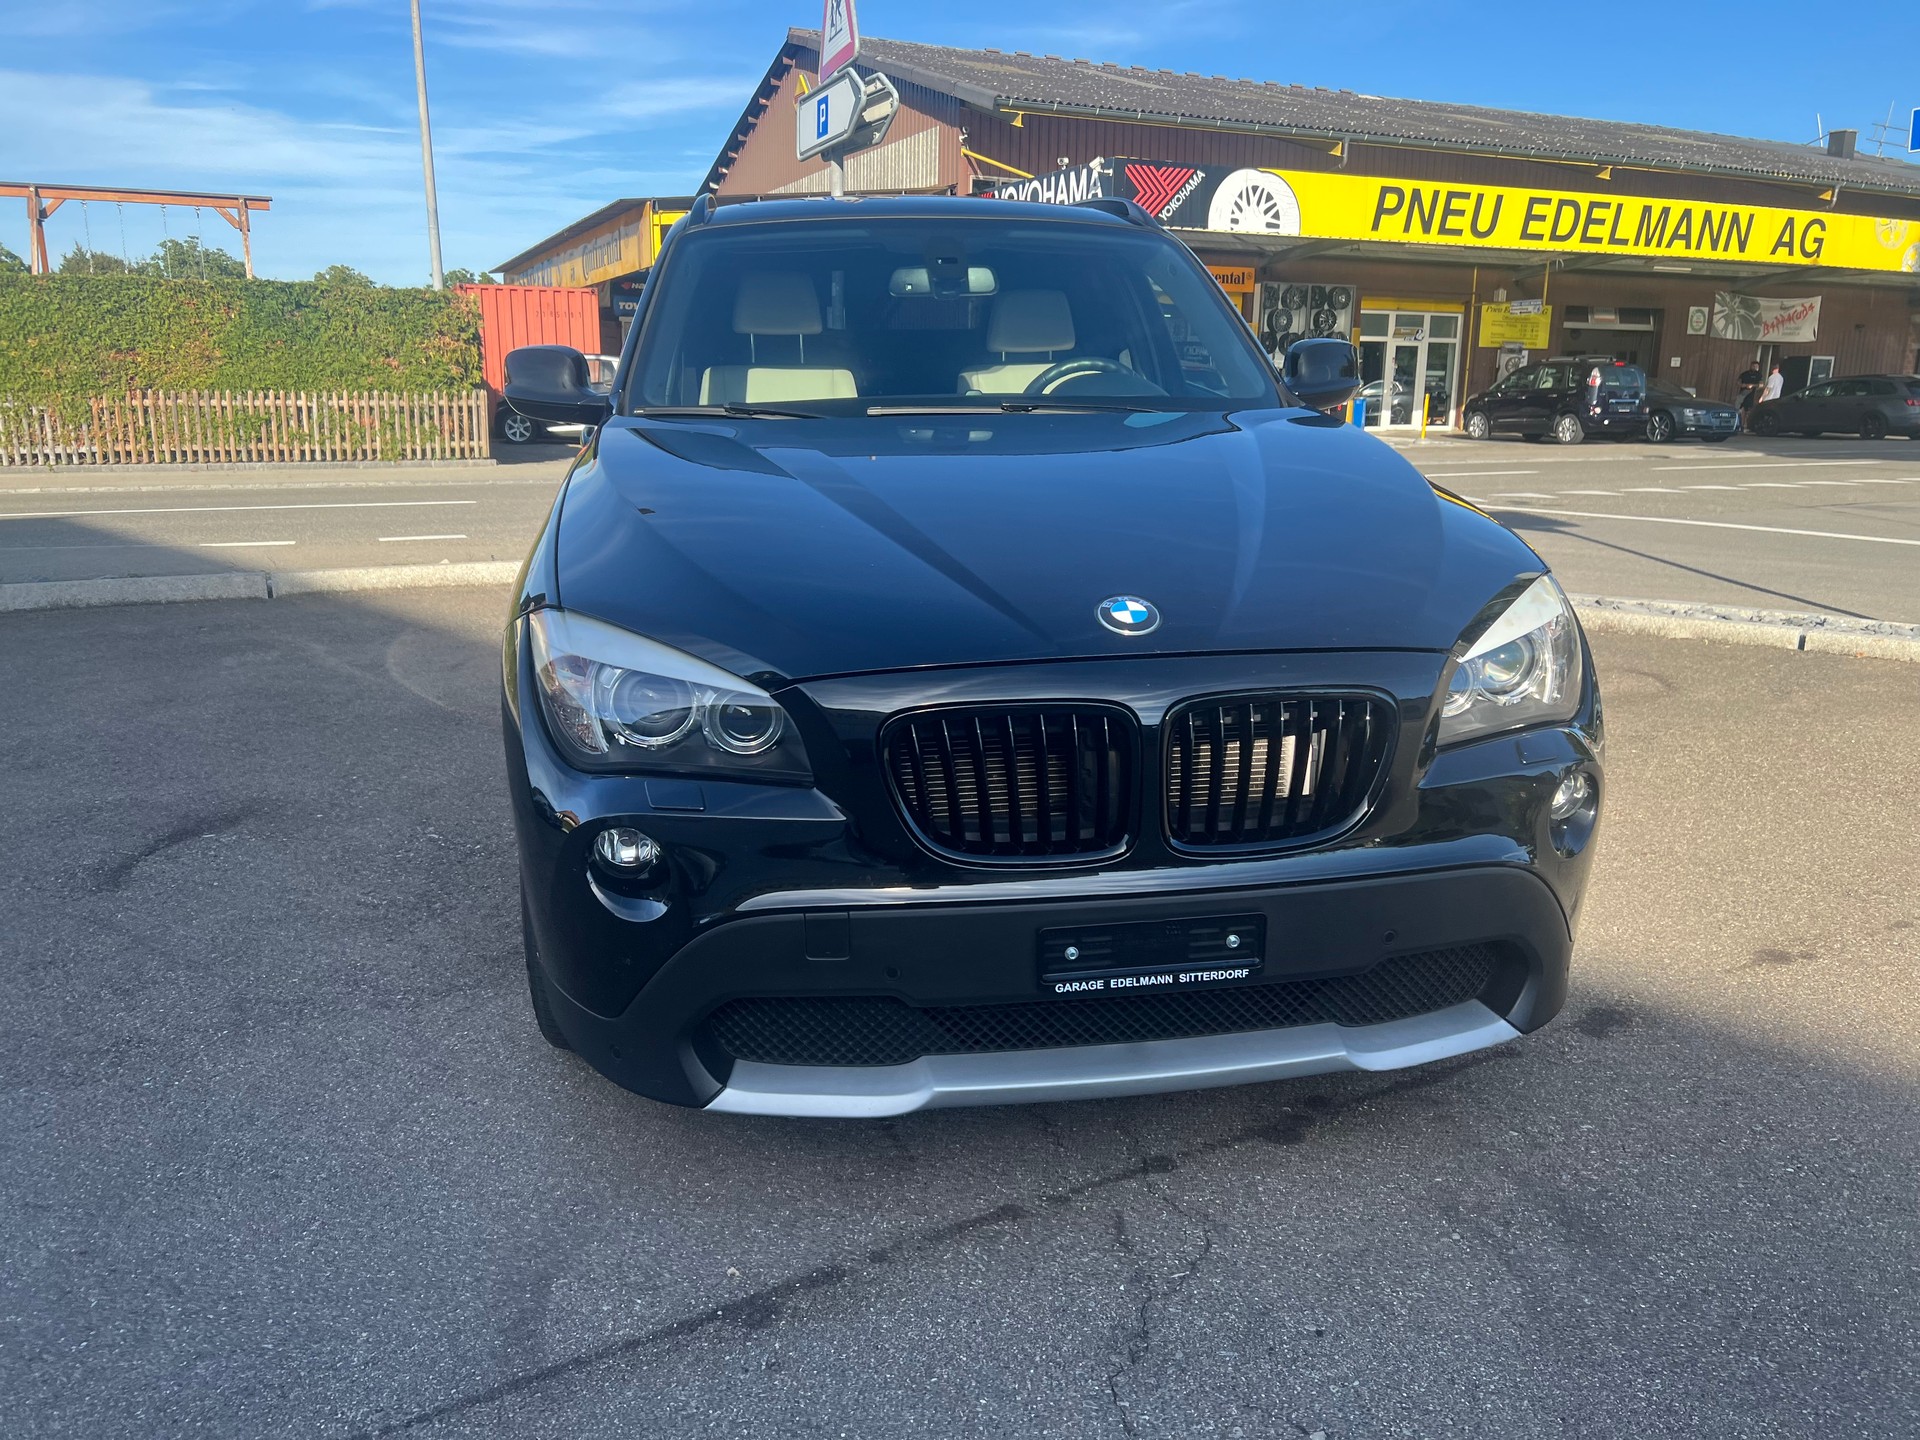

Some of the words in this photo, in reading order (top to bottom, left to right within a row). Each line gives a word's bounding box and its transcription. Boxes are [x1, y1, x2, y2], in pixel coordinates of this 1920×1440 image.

[820, 104, 826, 133] P
[1158, 170, 1206, 221] YOKOHAMA
[1371, 185, 1503, 239] PNEU
[1519, 197, 1755, 253] EDELMANN
[1769, 217, 1828, 259] AG
[1212, 272, 1246, 285] ental
[1055, 980, 1104, 993] GARAGE
[1110, 974, 1173, 989] EDELMANN
[1179, 969, 1249, 983] SITTERDORF
